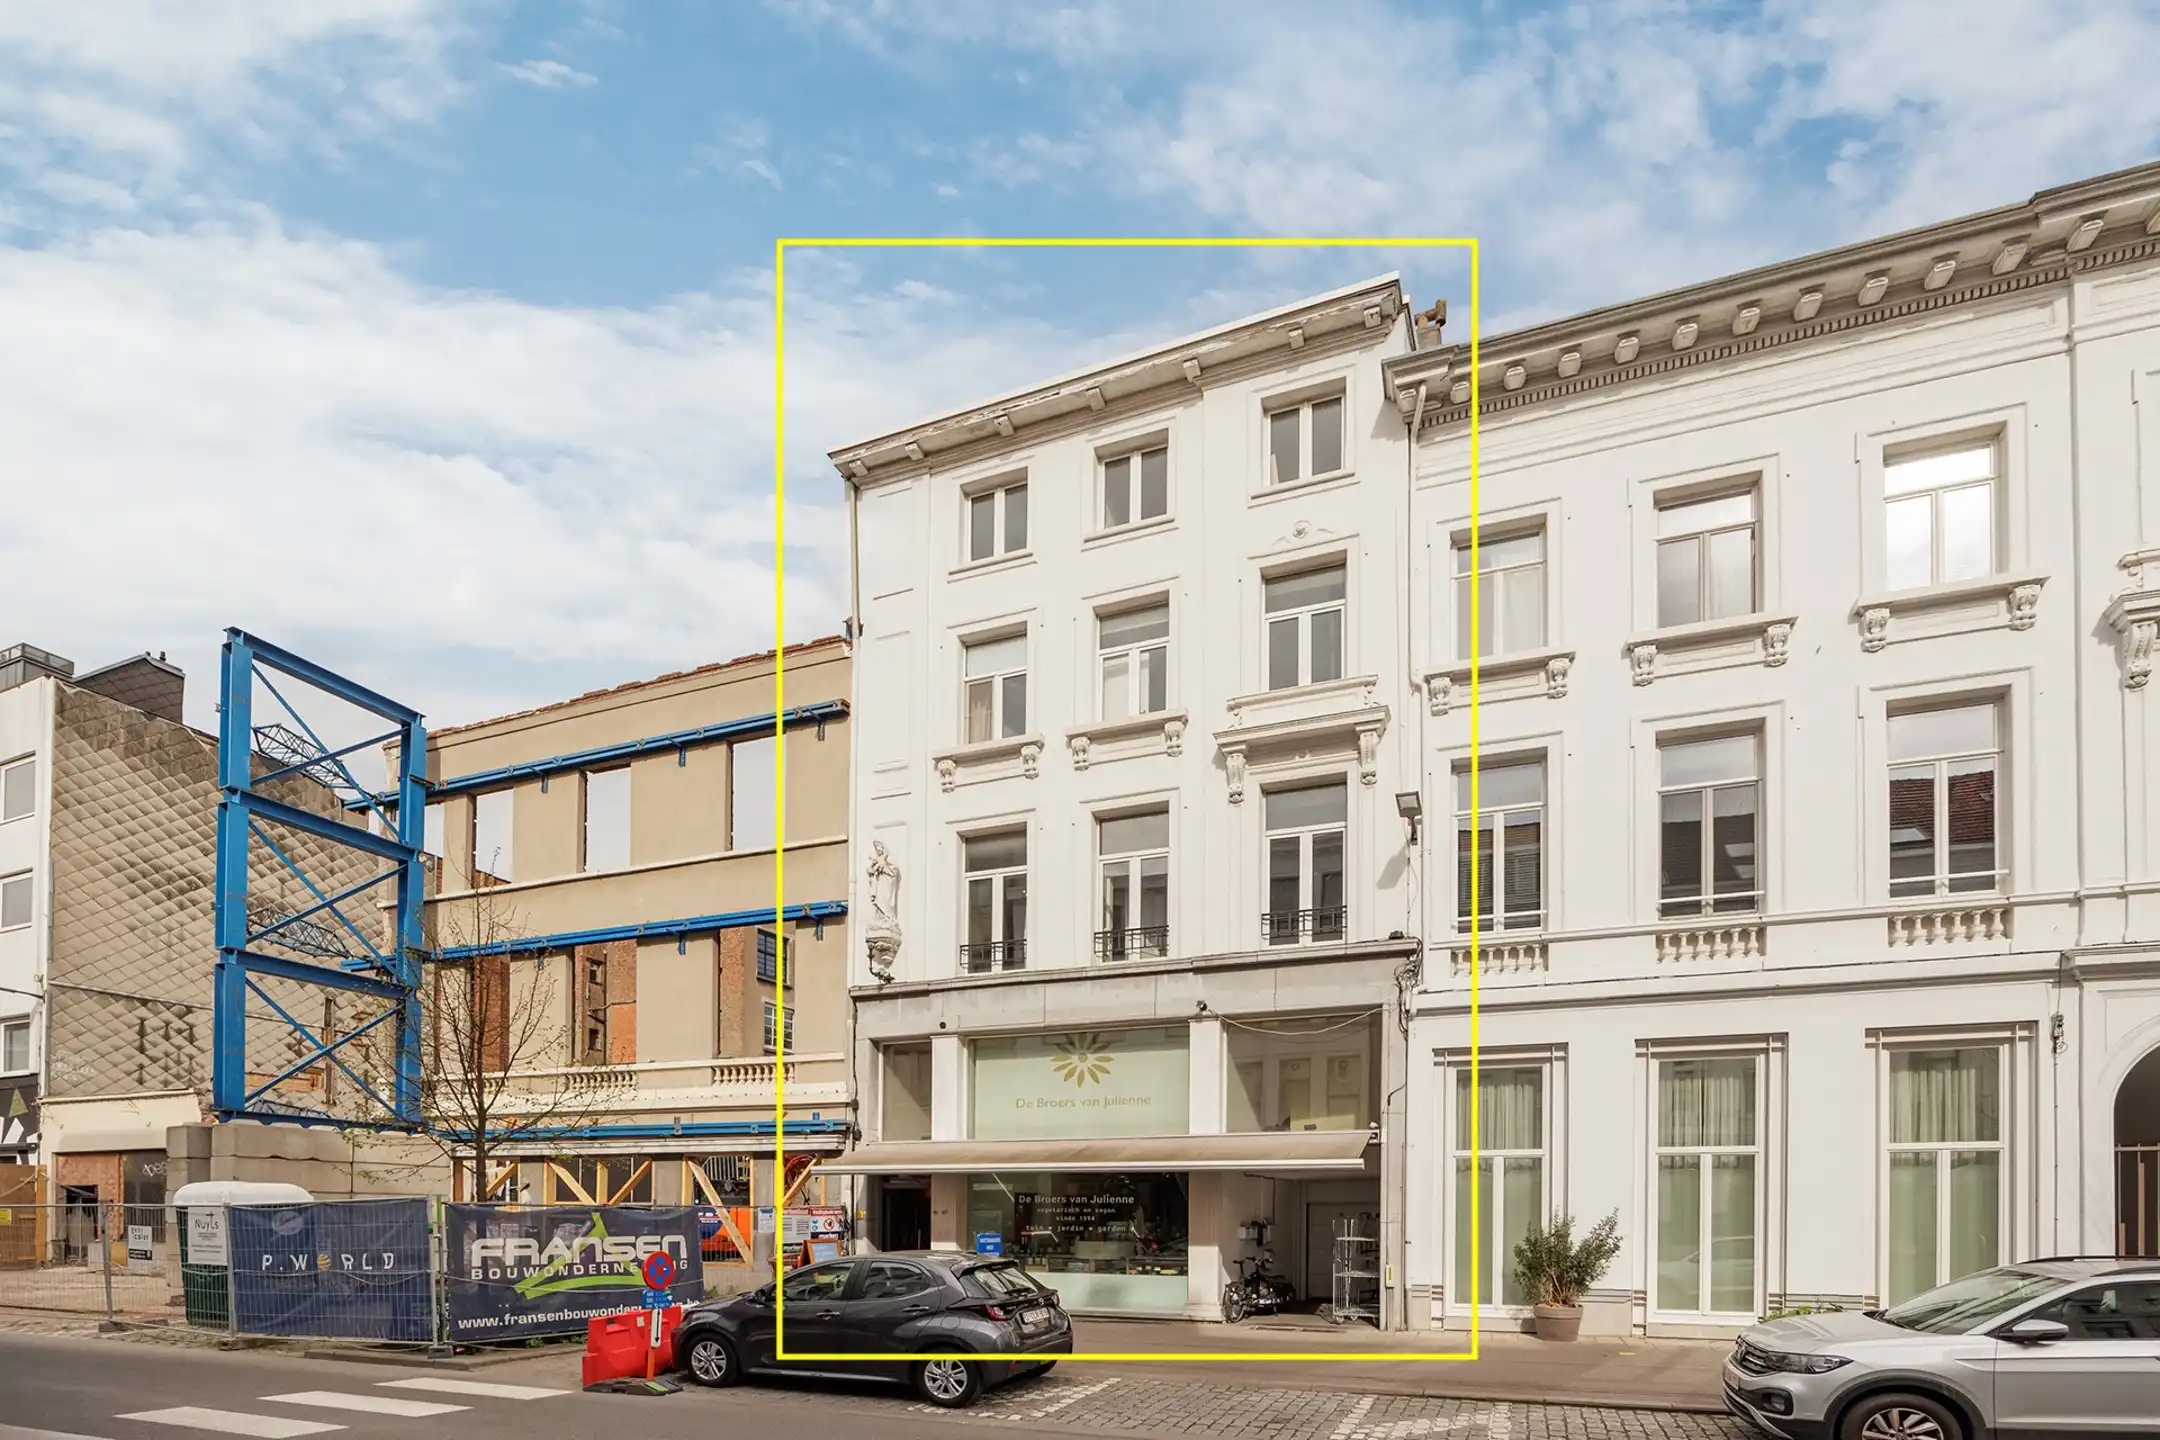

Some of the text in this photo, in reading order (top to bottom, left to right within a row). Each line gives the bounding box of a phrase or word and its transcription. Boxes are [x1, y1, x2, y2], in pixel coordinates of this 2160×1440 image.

[1015, 1094, 1151, 1108] De Broers van Julienne
[1019, 1193, 1135, 1204] De Broers van Julienne
[1026, 1223, 1126, 1233] tuin jardin garden
[471, 1234, 688, 1268] FRANSEN
